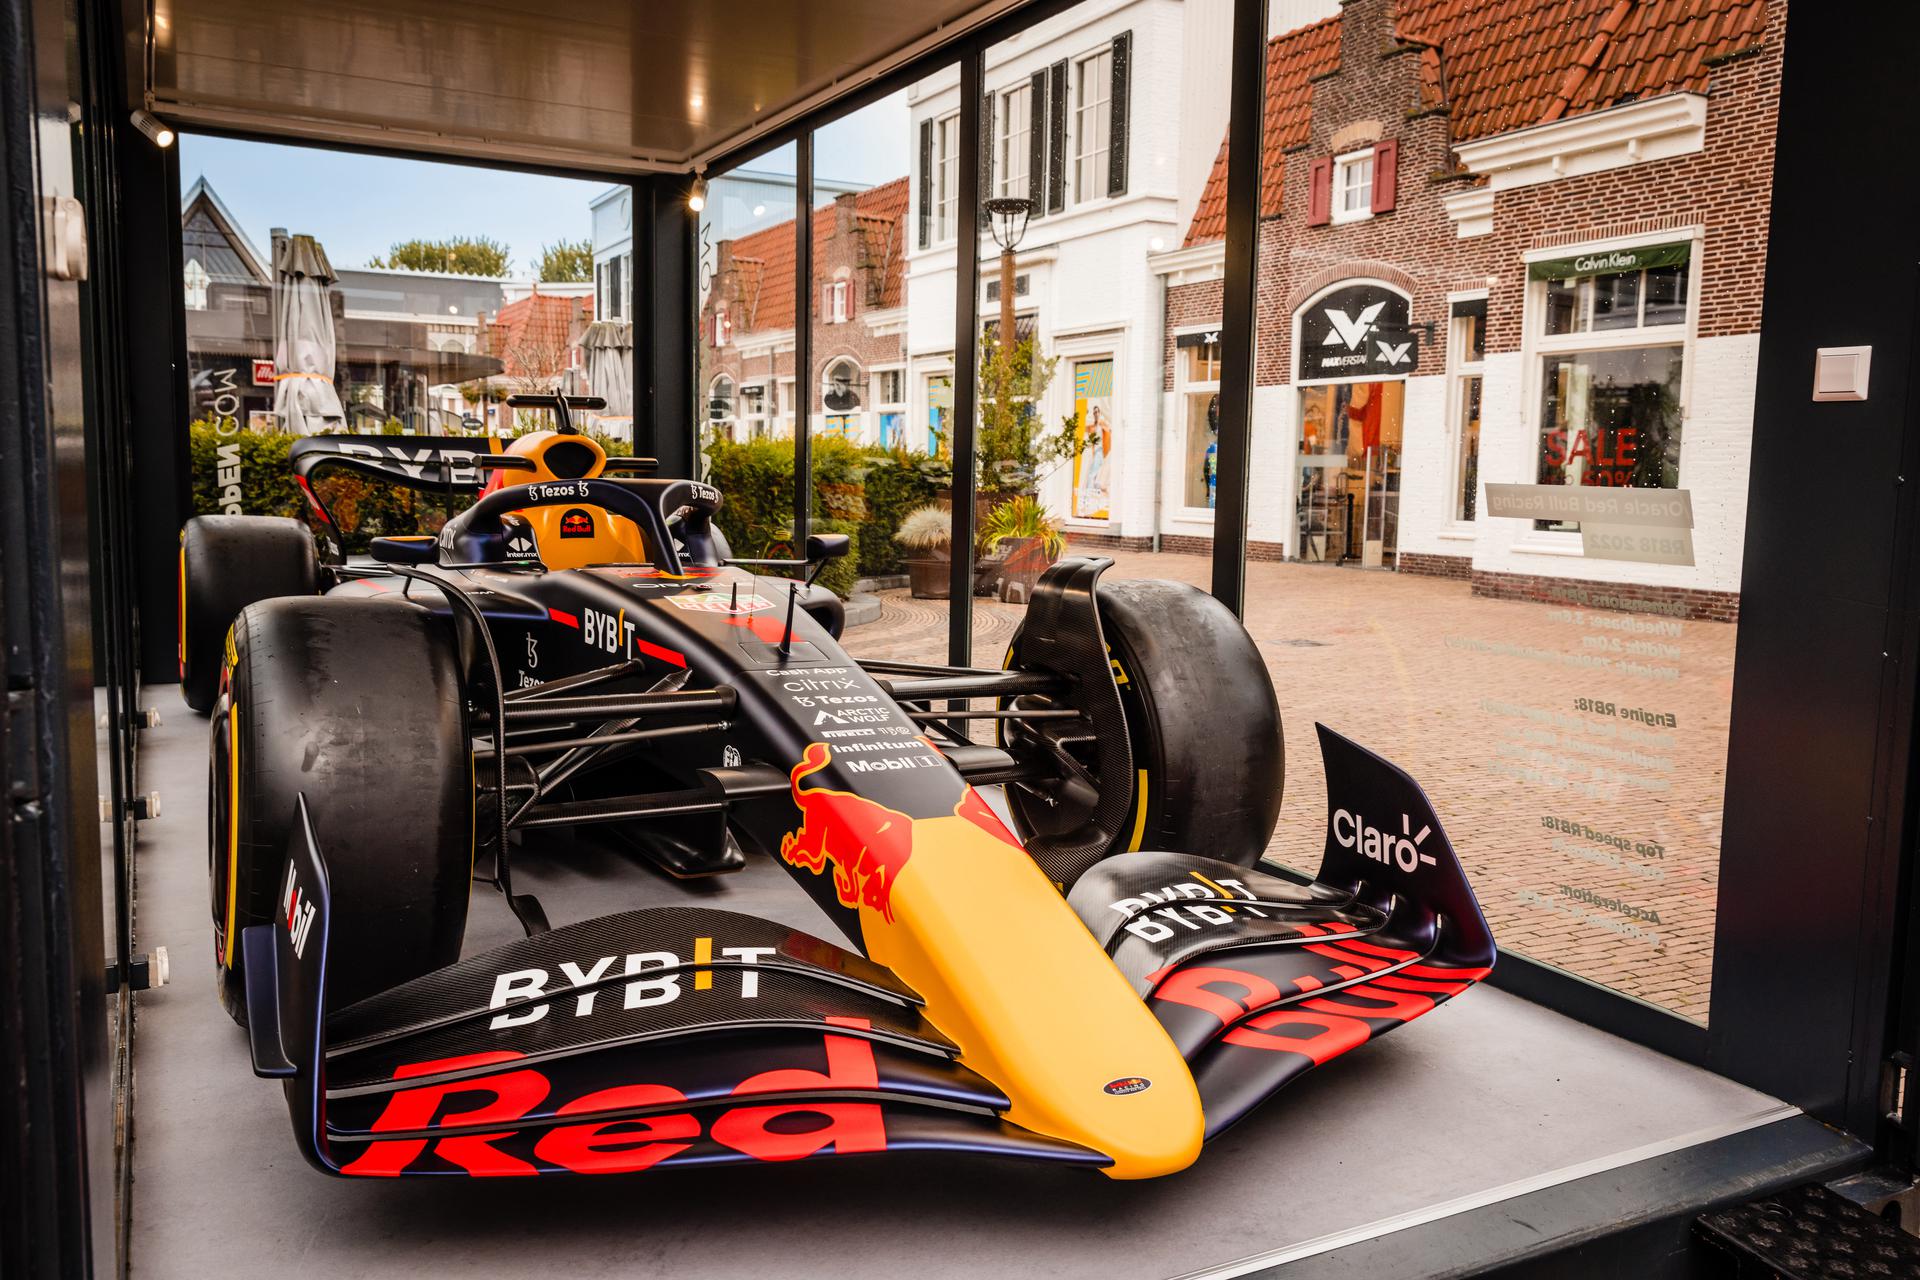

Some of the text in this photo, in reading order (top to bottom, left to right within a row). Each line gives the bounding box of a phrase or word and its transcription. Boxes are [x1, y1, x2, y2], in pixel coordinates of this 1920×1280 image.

[1575, 253, 1637, 272] Calvin Klein
[256, 365, 275, 381] illy
[1544, 428, 1637, 467] SALE
[540, 484, 575, 499] Tezos
[697, 485, 716, 501] Tezos
[562, 524, 591, 533] Red Bull
[584, 607, 636, 660] BYBIT
[766, 667, 848, 676] Cash App
[814, 695, 878, 705] Tezos
[837, 707, 890, 717] ARCTIC
[847, 714, 891, 723] WOLF
[821, 728, 877, 738] PIRELLI
[845, 757, 917, 773] Mobil
[1333, 808, 1419, 873] Claro
[283, 858, 317, 960] Mobil
[1108, 871, 1269, 943] BYBIT
[489, 937, 776, 1031] BYBIT
[339, 1016, 888, 1178] Red
